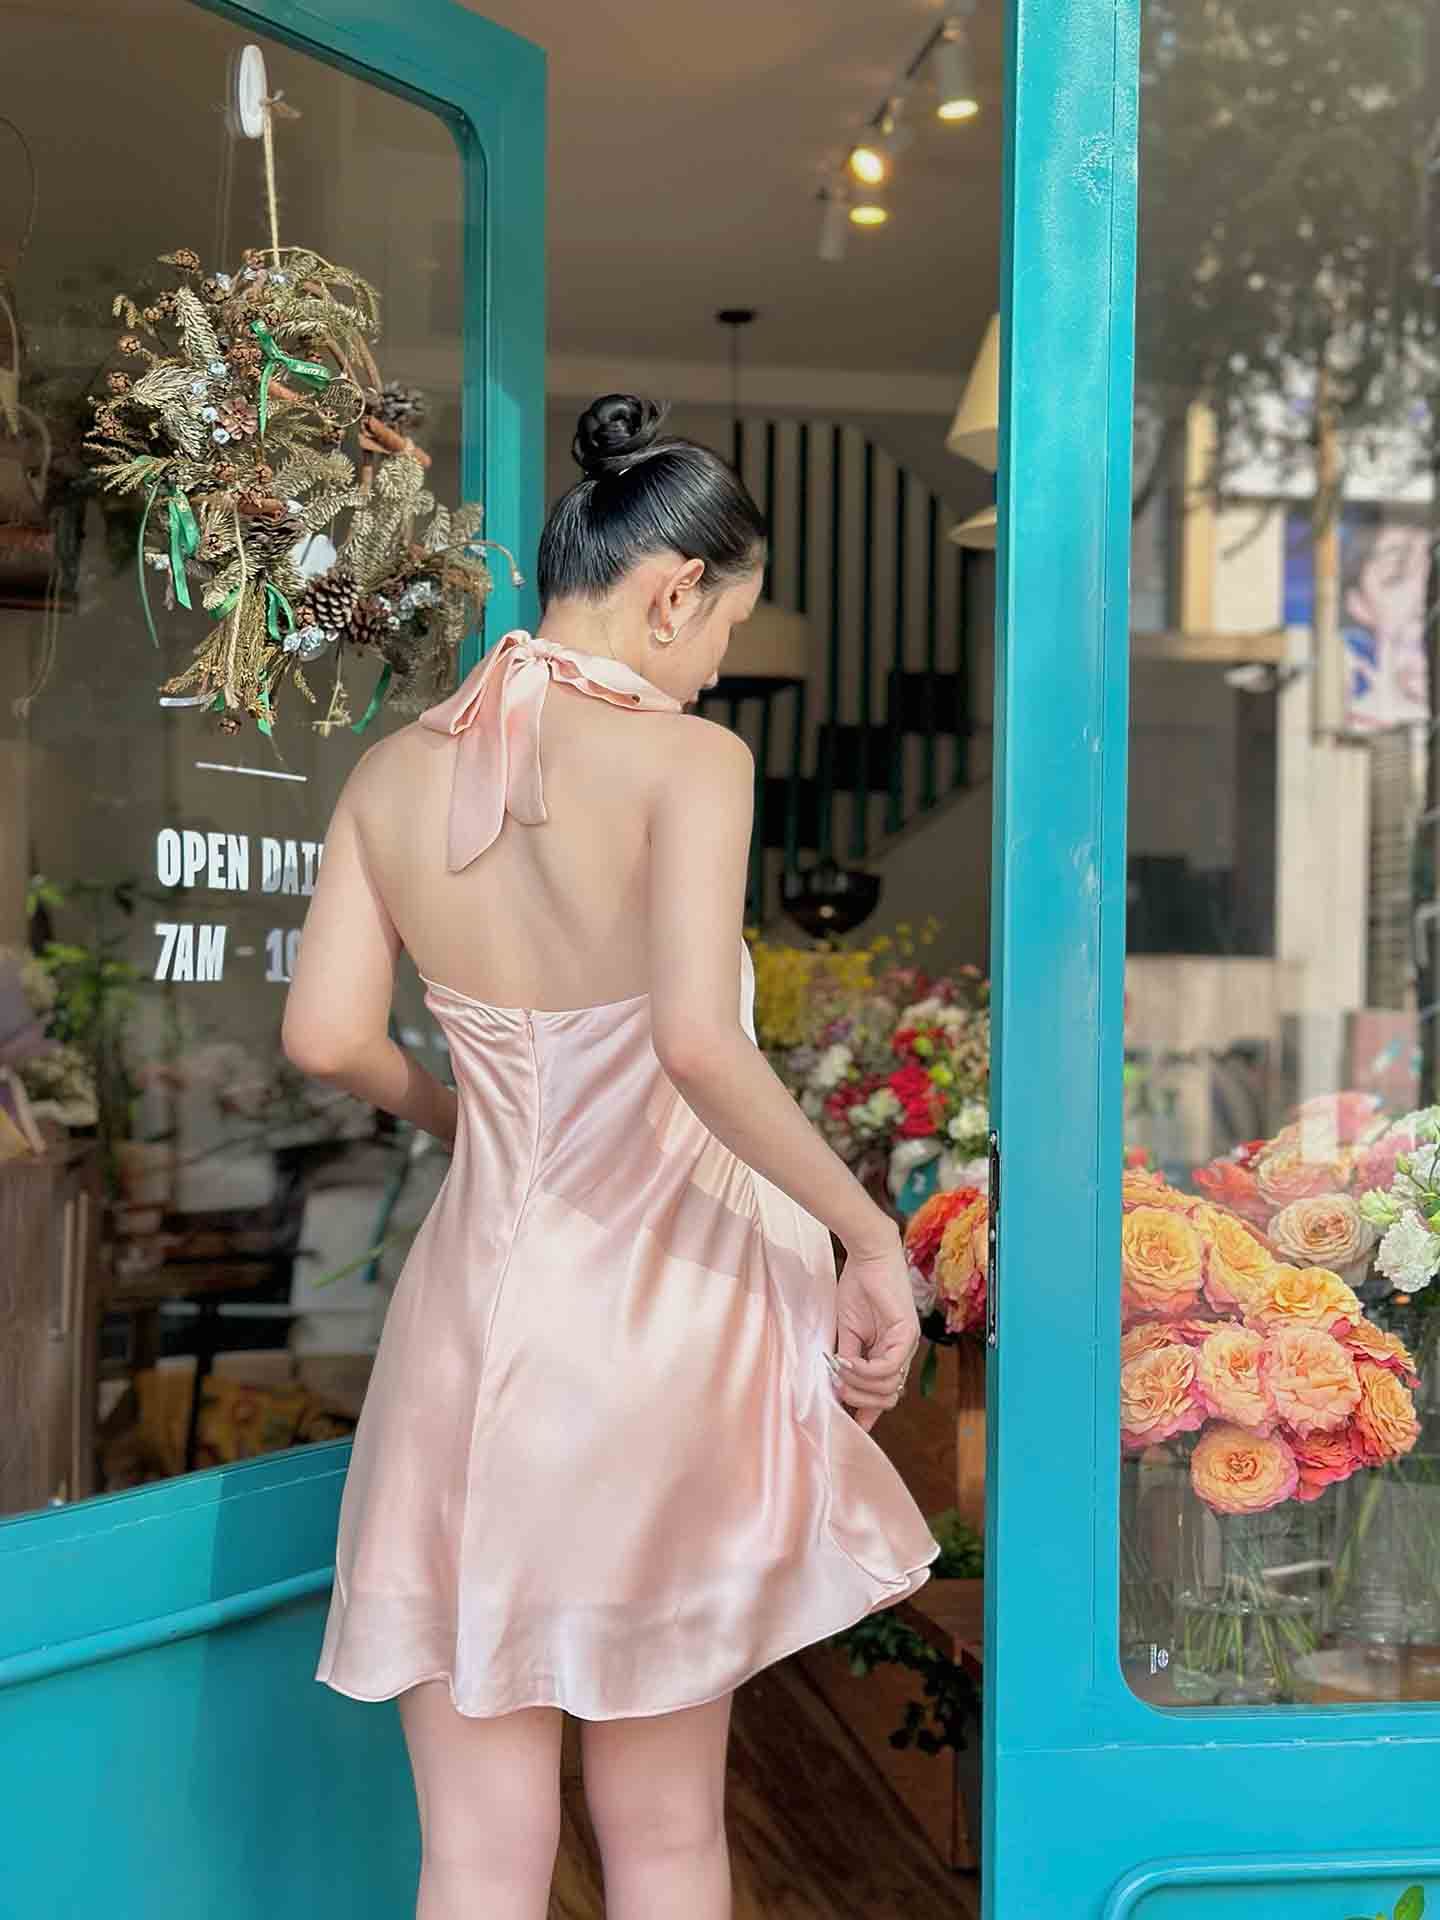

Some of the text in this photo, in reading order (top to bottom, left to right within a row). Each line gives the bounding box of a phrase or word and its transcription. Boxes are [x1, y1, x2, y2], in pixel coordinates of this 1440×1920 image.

[157, 828, 324, 896] OPEN DAI
[154, 923, 227, 981] 7AM
